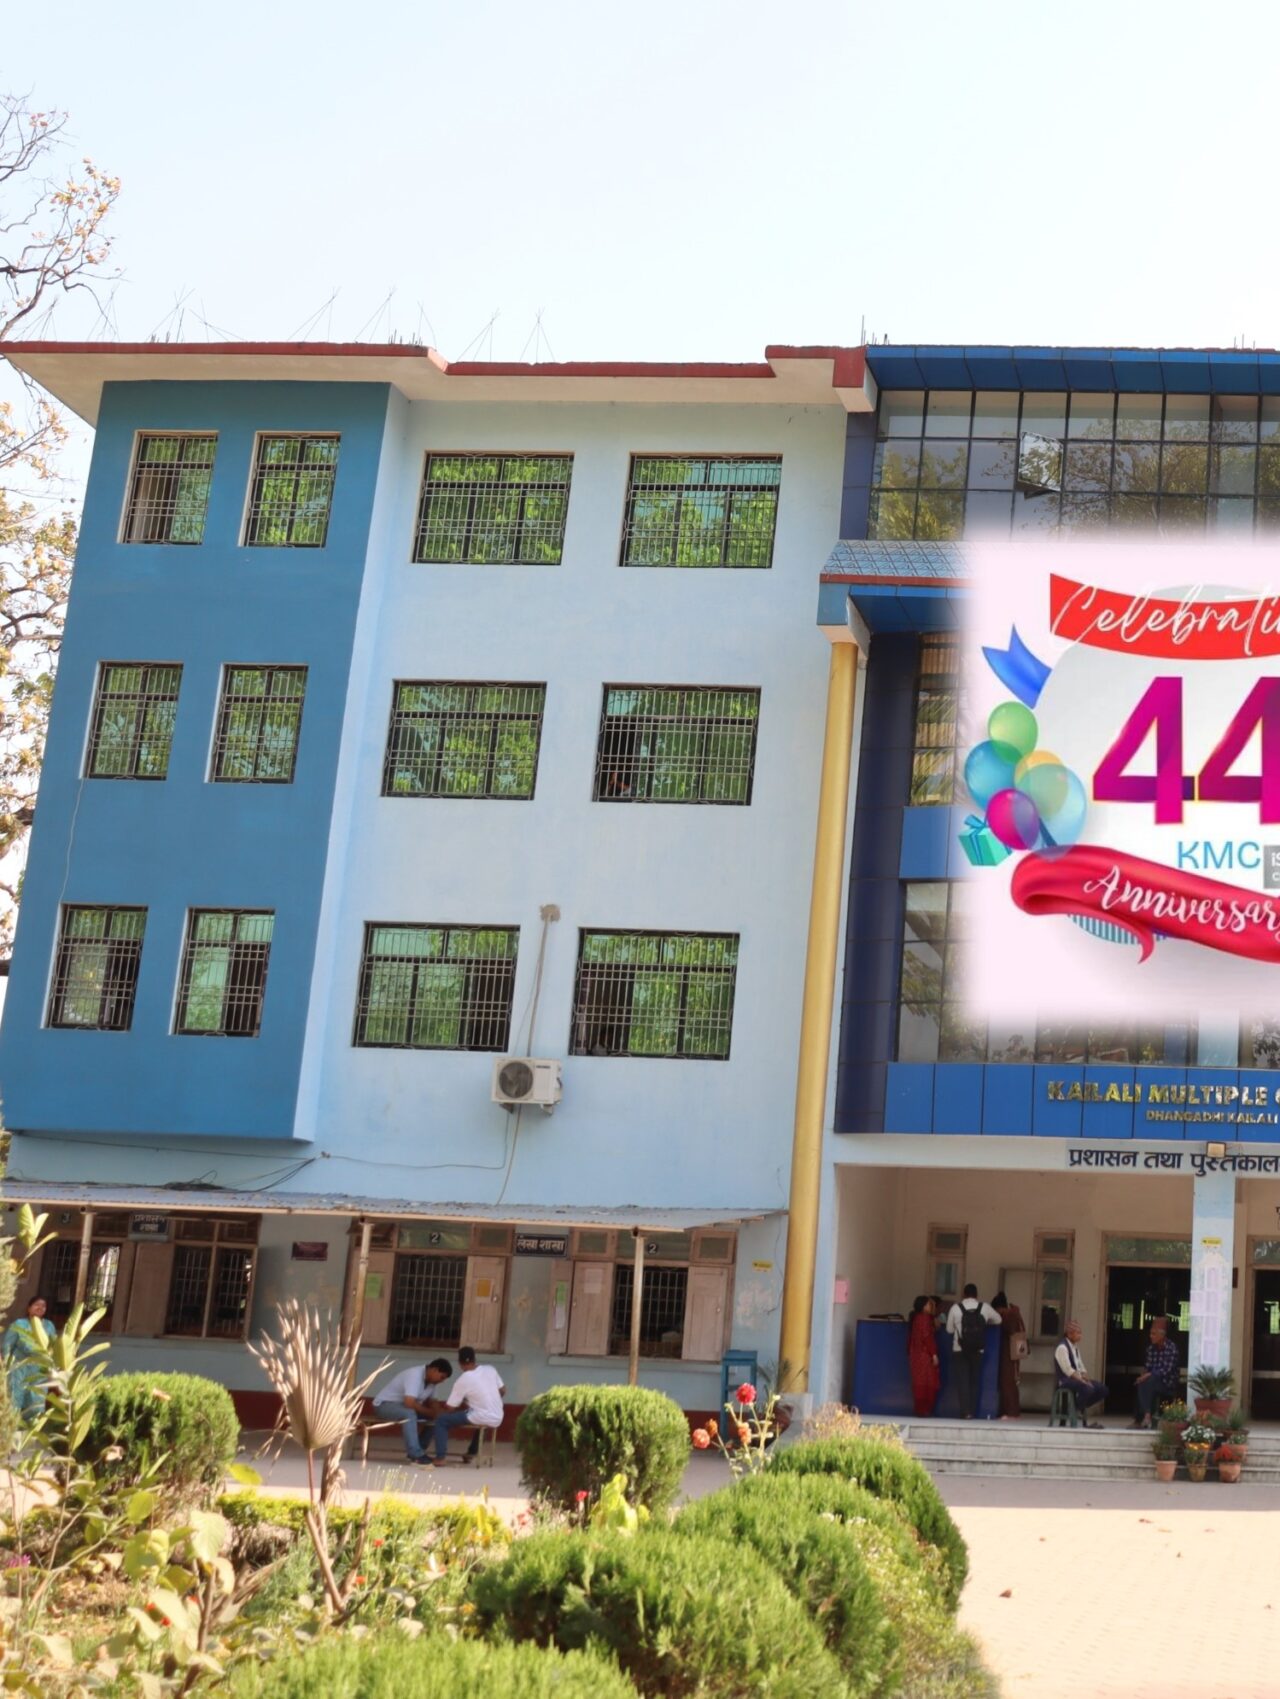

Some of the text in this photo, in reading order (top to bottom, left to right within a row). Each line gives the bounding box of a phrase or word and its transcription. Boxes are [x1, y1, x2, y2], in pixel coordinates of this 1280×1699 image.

[1047, 1080, 1142, 1103] KAILALI
[1148, 1083, 1268, 1107] MULTIPLE
[1069, 1149, 1137, 1169] प्रशासन
[1143, 1151, 1182, 1170] तथा
[431, 1232, 441, 1243] 2
[648, 1243, 657, 1254] 2
